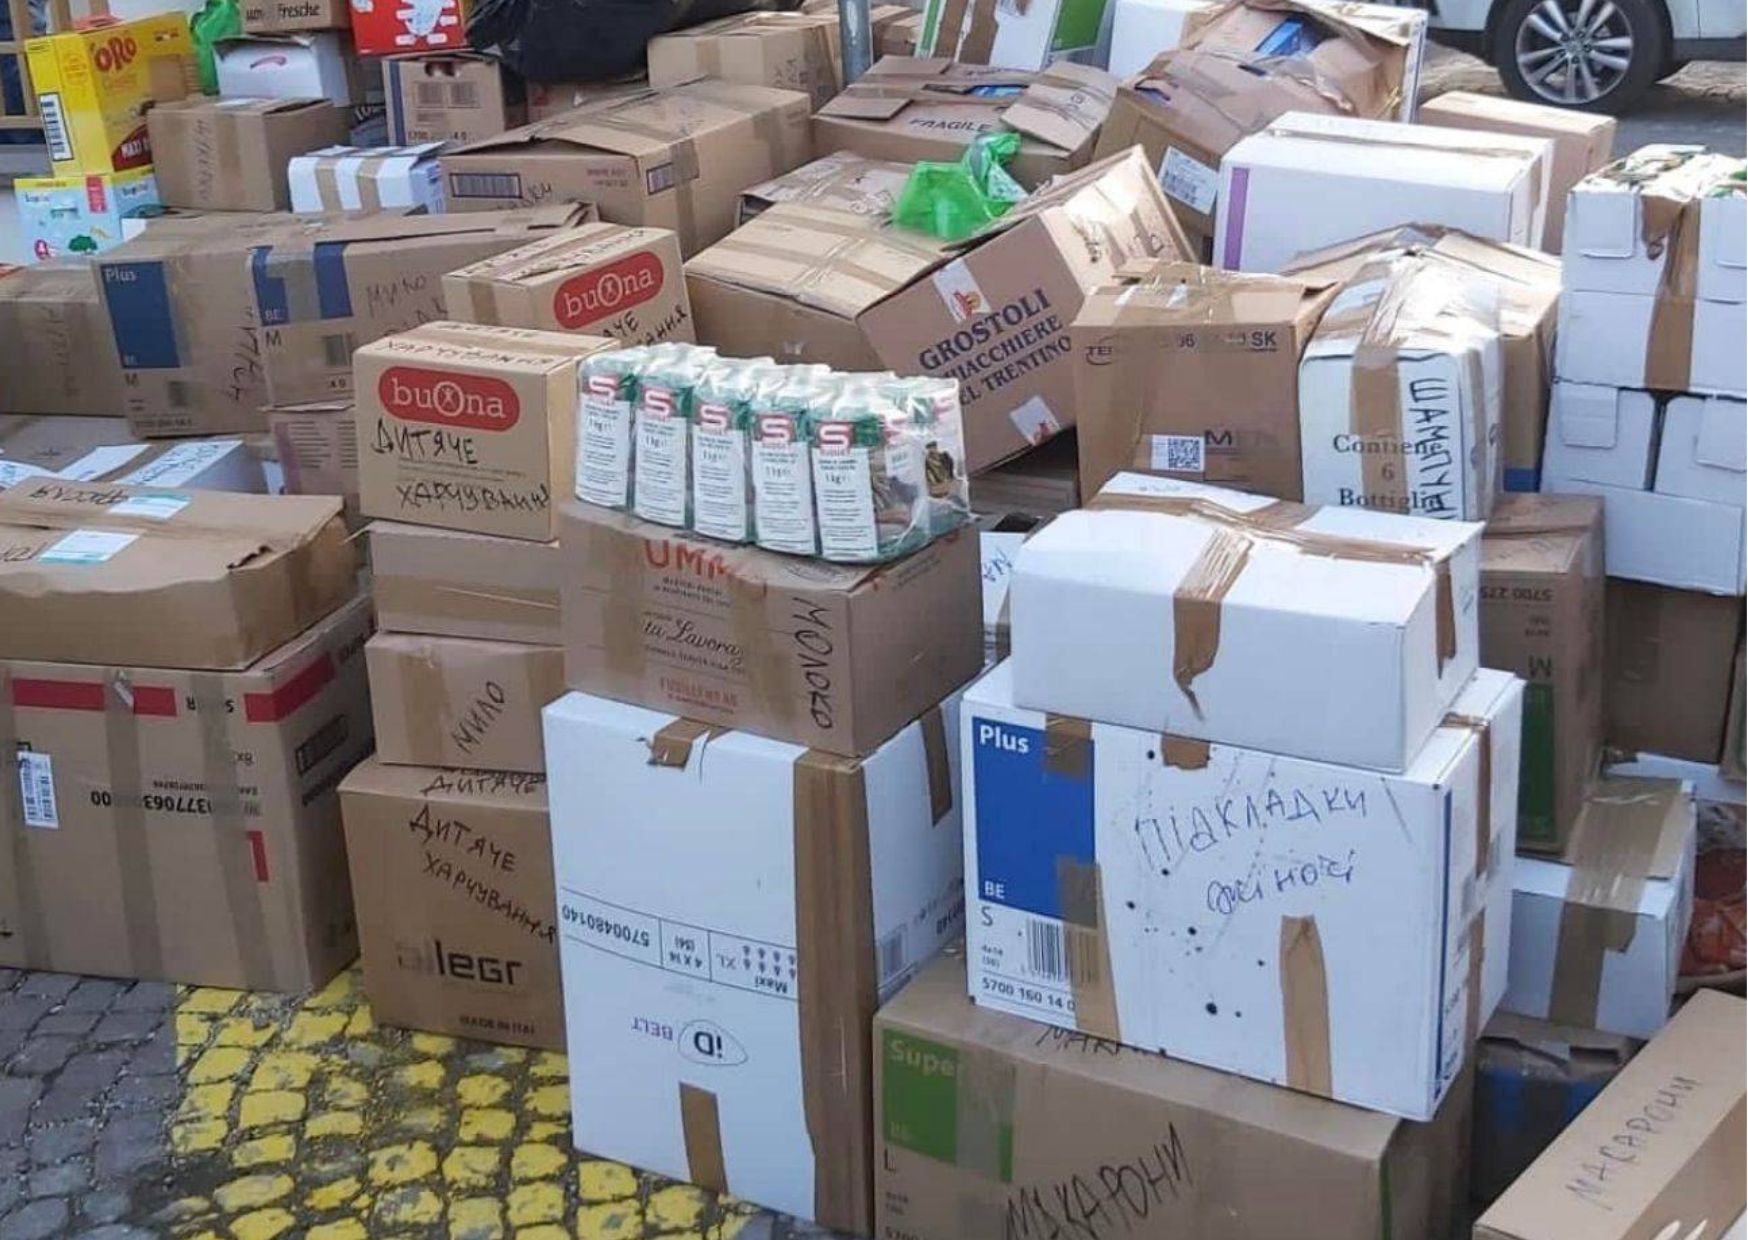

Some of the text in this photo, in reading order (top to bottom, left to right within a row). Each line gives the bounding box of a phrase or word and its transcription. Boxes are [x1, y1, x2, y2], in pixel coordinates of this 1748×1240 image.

[910, 117, 994, 133] FRAGILE
[104, 267, 138, 283] Plus
[563, 267, 655, 319] buona
[919, 287, 1051, 370] GROSTOLI
[943, 314, 1064, 384] HIACCHIERE
[981, 335, 1073, 393] TRENTINO
[390, 376, 506, 418] buona
[371, 417, 479, 465] ДИТЯЧЕ
[1408, 377, 1458, 521] ШАМПУН
[1382, 463, 1395, 481] 6
[791, 597, 834, 730] МОЛОКО
[979, 725, 1030, 754] Plus
[409, 804, 517, 873] ДИТЯЧЕ
[1134, 786, 1368, 873] ПІДКЛАДКИ
[984, 880, 1005, 899] BE
[981, 905, 994, 928] S
[754, 974, 789, 995] Maxi
[982, 977, 1015, 997] 5700
[1019, 989, 1043, 1004] 160
[1048, 995, 1063, 1007] 14
[631, 1016, 674, 1041] BELT
[890, 1040, 955, 1078] Supe
